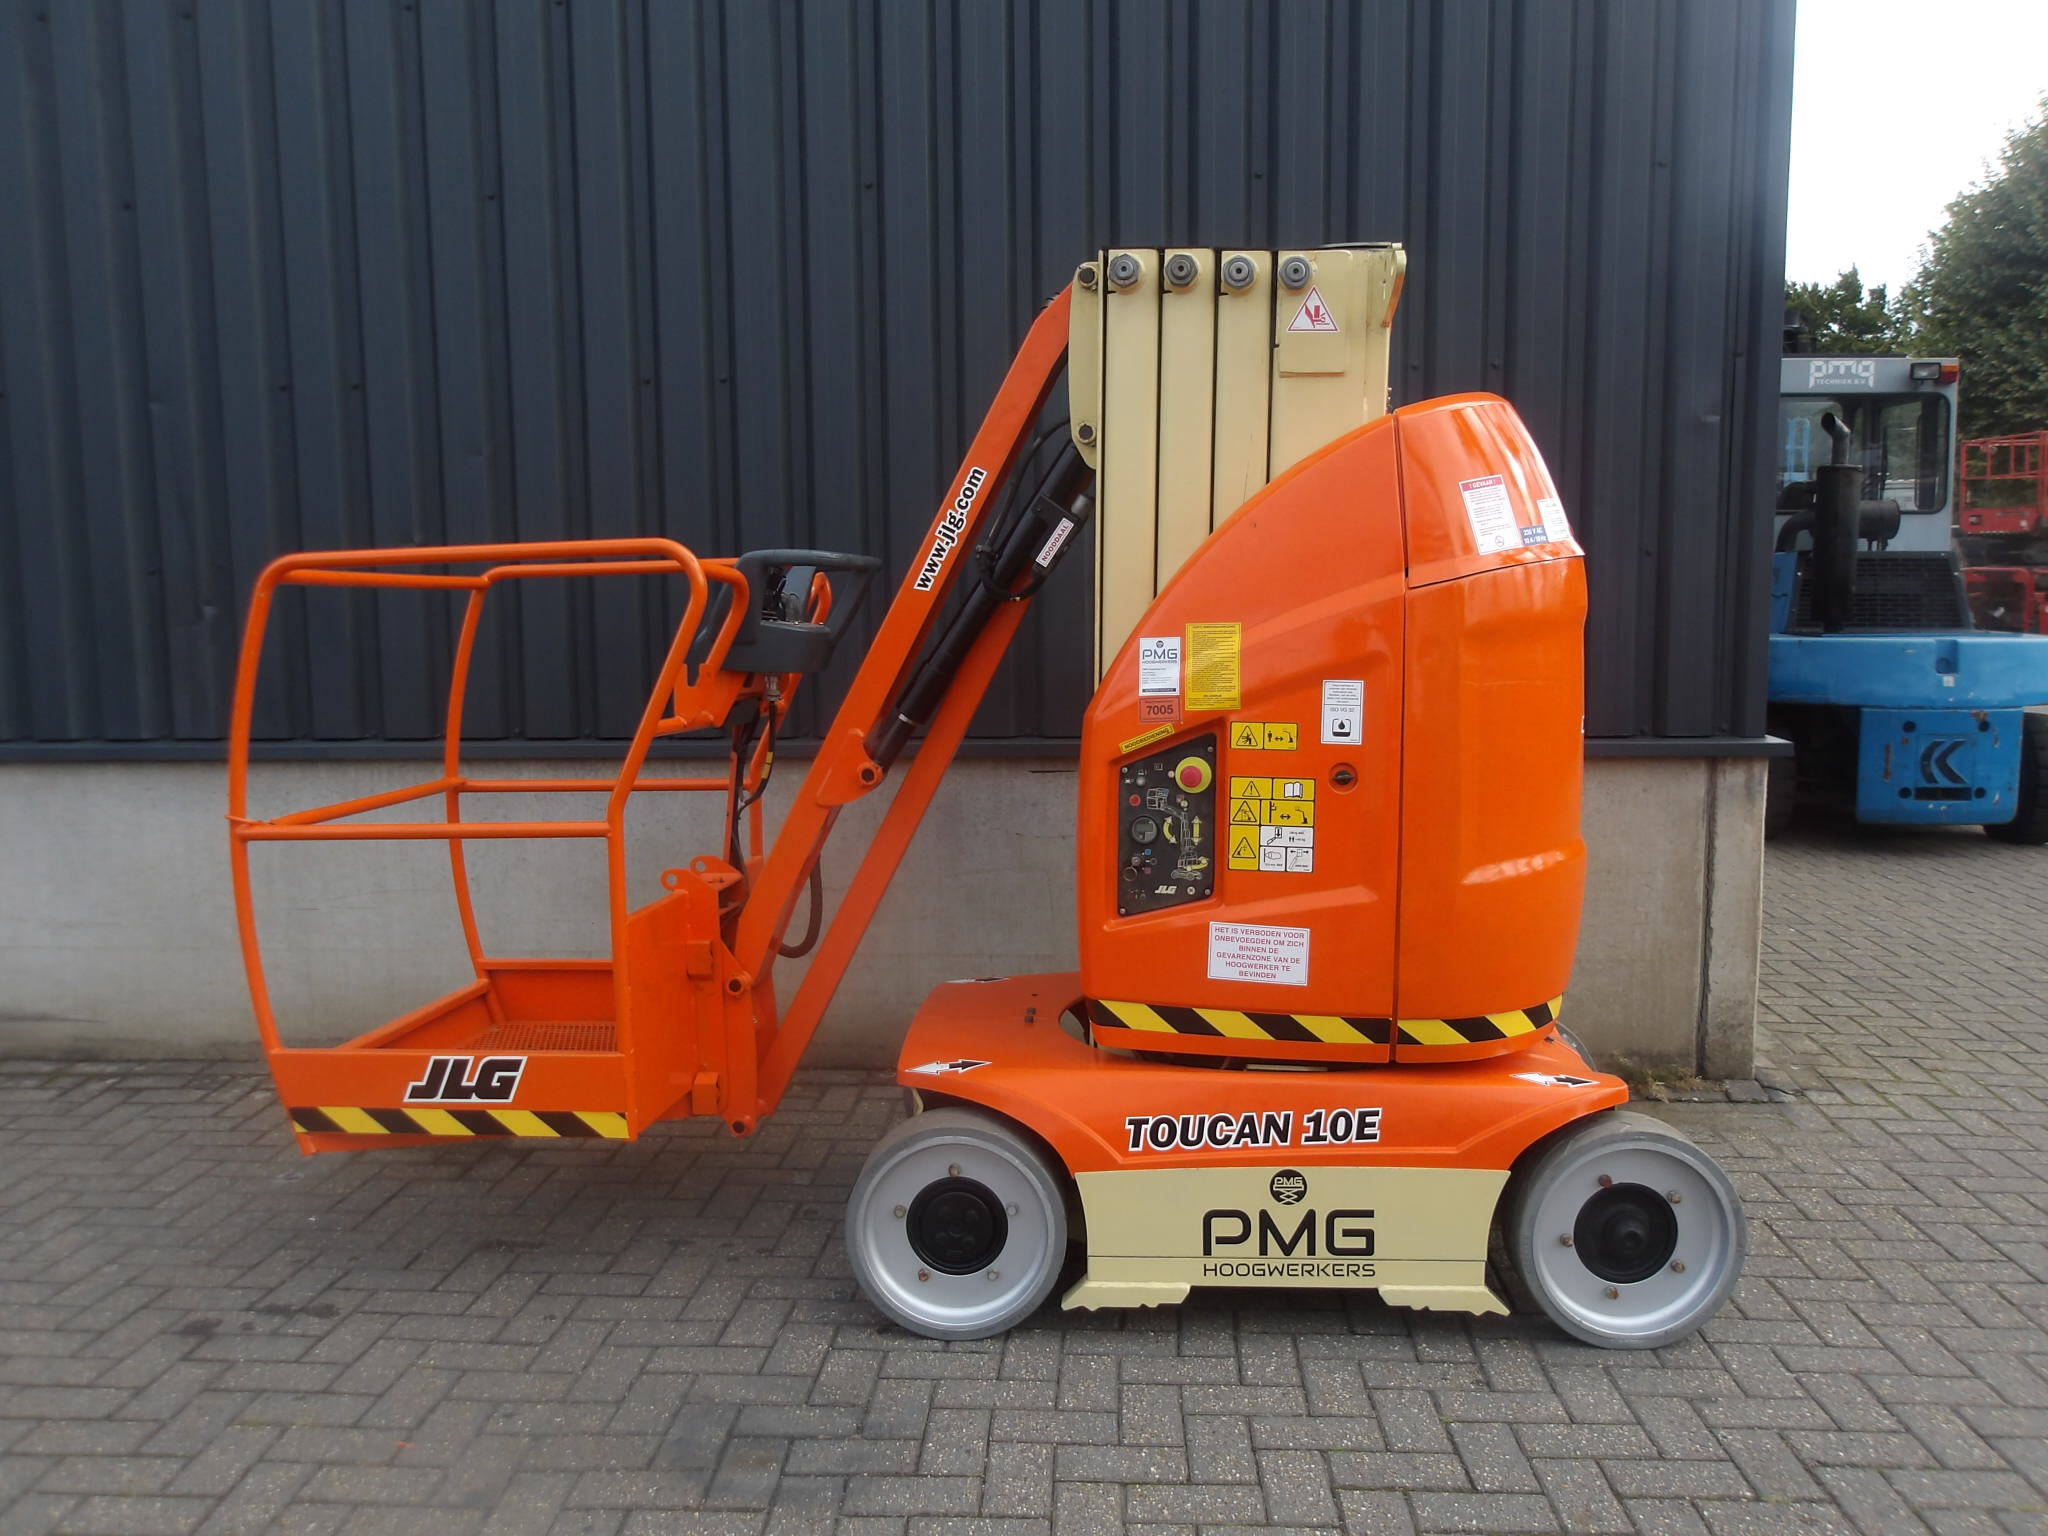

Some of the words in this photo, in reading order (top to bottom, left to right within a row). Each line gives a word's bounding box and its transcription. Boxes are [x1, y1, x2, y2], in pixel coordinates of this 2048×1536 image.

[914, 467, 987, 591] www.jlg.com
[1041, 524, 1070, 562] NOODDAAL
[1142, 648, 1178, 660] PMG
[1146, 704, 1174, 715] 7005
[1154, 885, 1177, 894] JLG
[1240, 928, 1281, 937] VERBODEN
[1214, 934, 1271, 945] ONBEVOEGDEN
[1287, 940, 1305, 948] ZICH
[1238, 945, 1266, 953] BINNEN
[1216, 951, 1271, 962] GEVARENZONE
[1225, 961, 1279, 971] HOOGWERKER
[1238, 970, 1277, 979] BEVINDEN
[403, 1056, 528, 1102] JLG
[1126, 1111, 1293, 1151] TOUCAN
[1301, 1108, 1382, 1145] 10E
[1274, 1176, 1303, 1187] PMG
[1203, 1208, 1375, 1257] PMG
[1203, 1262, 1376, 1277] HOOGWERKERS
